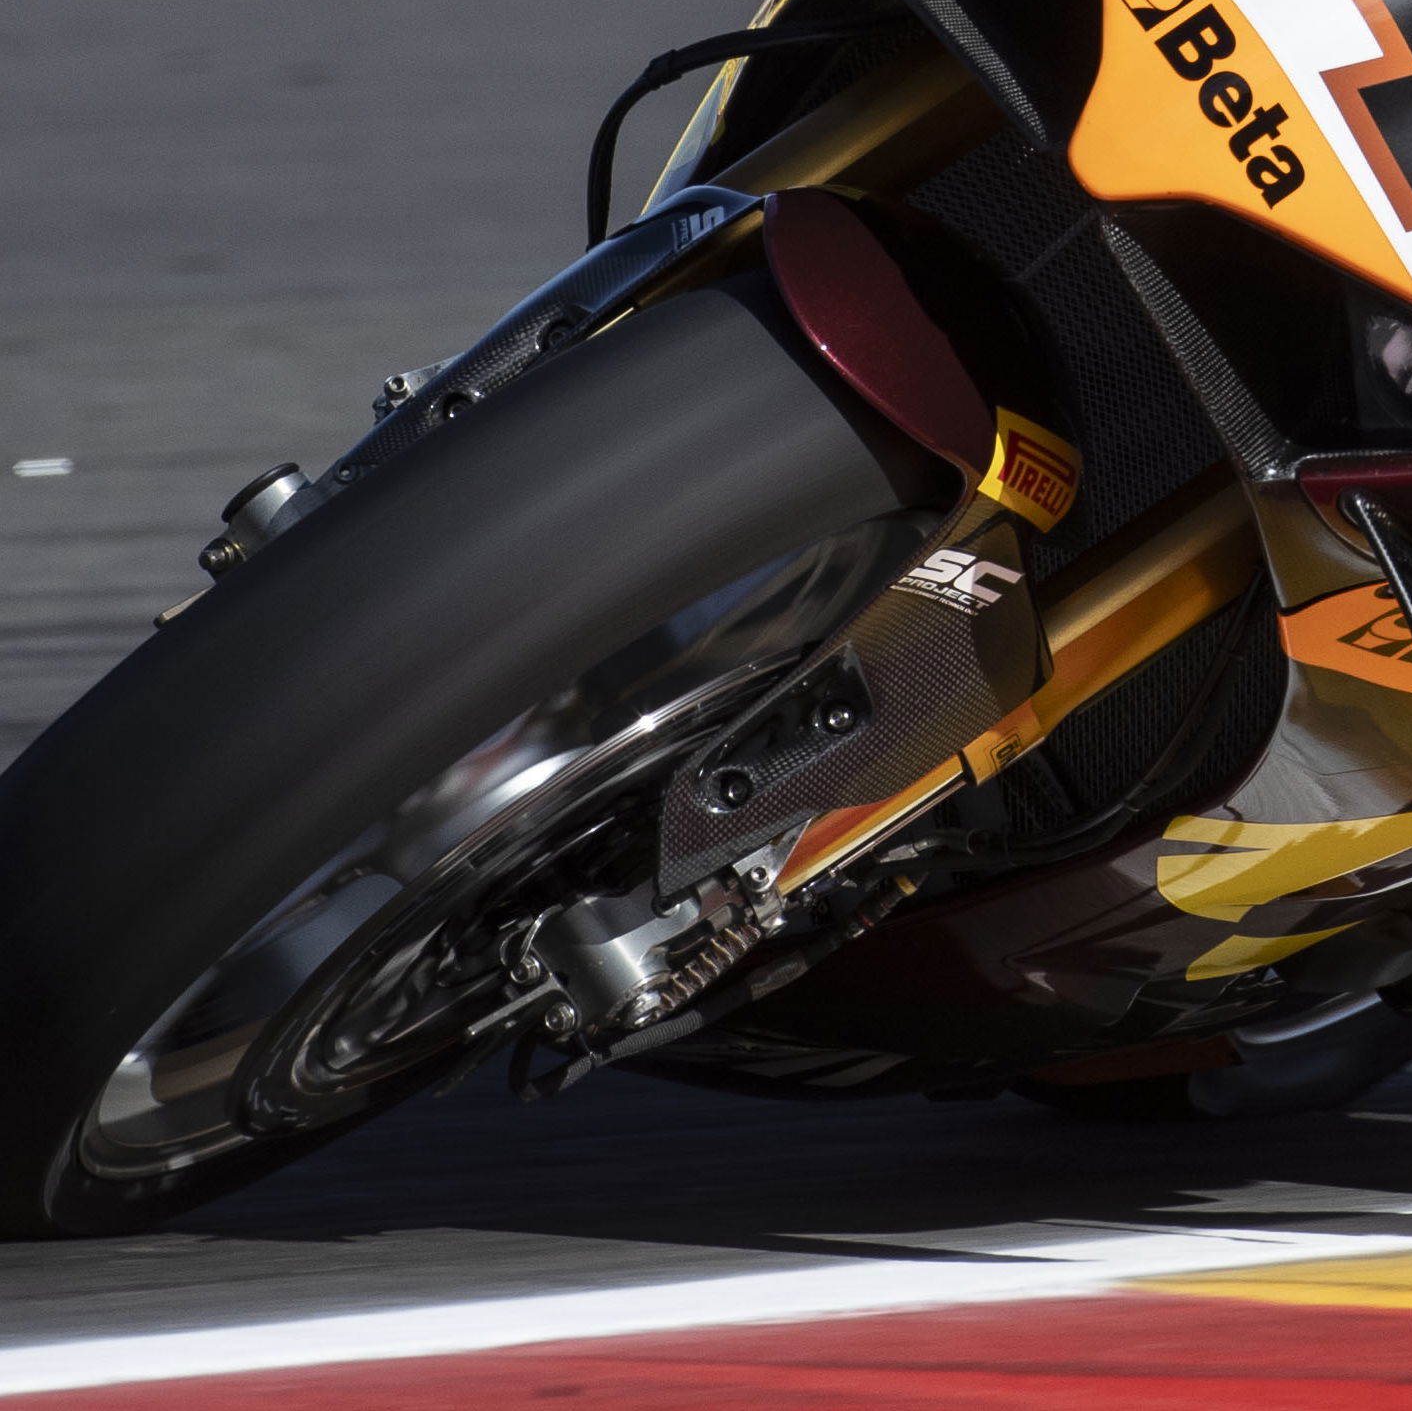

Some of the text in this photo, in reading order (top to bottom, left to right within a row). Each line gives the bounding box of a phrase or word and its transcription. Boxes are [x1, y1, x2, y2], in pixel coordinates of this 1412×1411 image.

[1153, 2, 1306, 210] Beta
[997, 429, 1076, 517] PIRELLI
[898, 576, 990, 610] PROJECT
[907, 548, 1026, 604] SC
